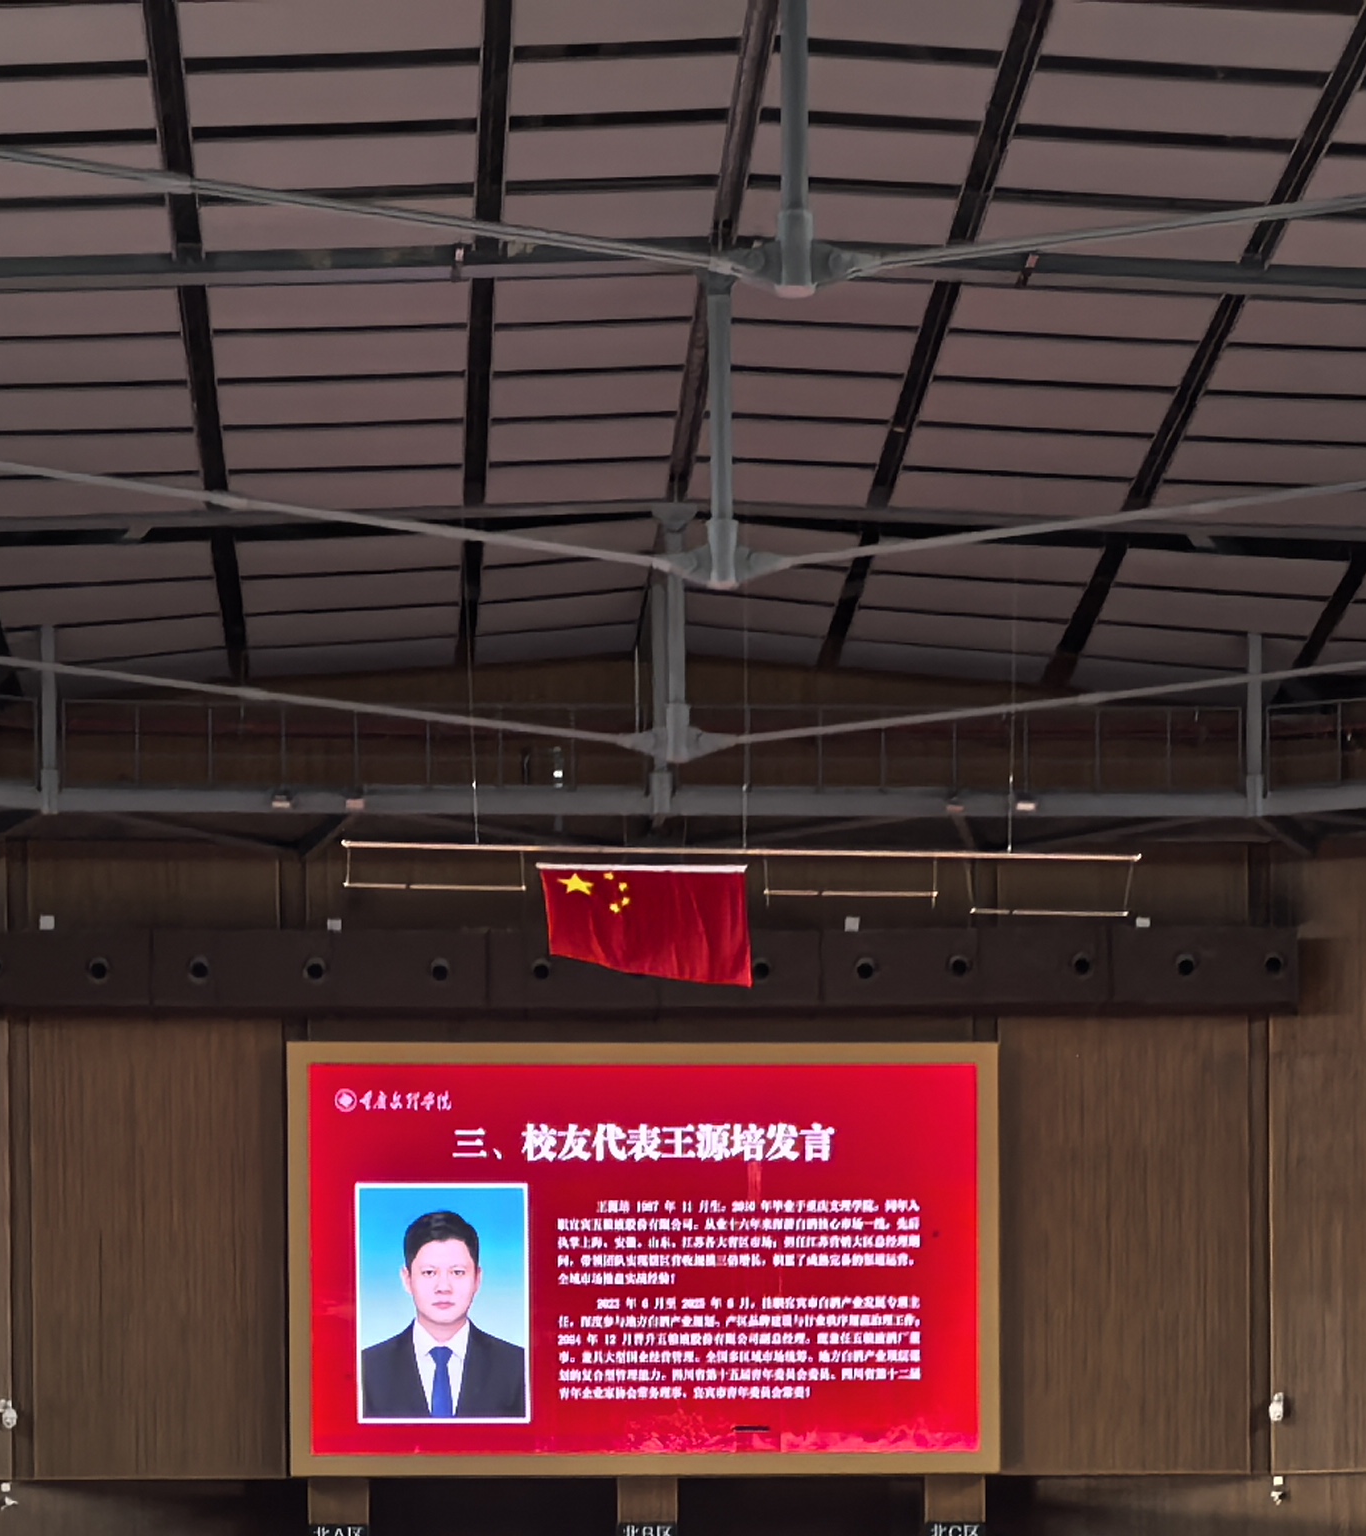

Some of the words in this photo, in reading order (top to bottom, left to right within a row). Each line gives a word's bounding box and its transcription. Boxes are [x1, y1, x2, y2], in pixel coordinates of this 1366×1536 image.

[451, 1121, 836, 1163] 三、校友代表王源培发言
